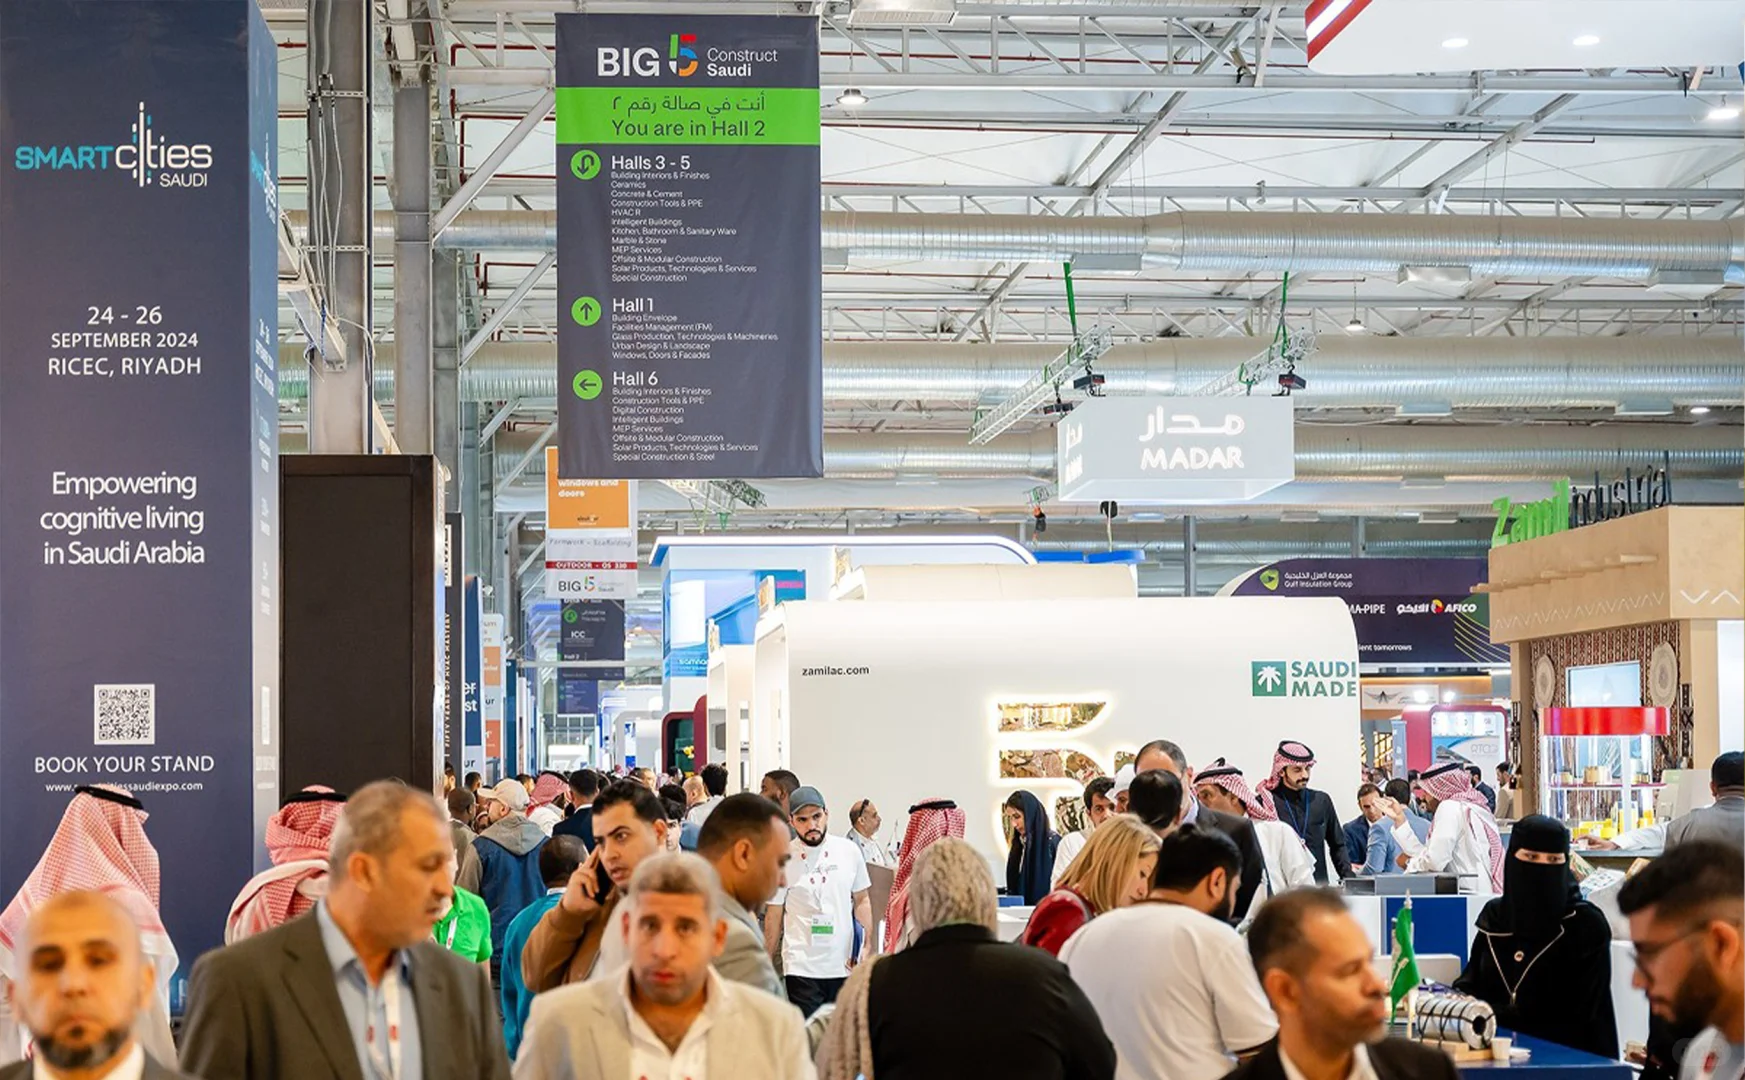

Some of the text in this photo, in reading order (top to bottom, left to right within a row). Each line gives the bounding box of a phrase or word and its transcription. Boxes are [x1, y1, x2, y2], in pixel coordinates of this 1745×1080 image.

[707, 48, 778, 62] Construct
[598, 48, 660, 77] BIG
[706, 63, 751, 76] Saudi
[662, 96, 700, 110] صالة
[736, 90, 765, 110] أنت
[628, 97, 656, 118] رقم
[706, 97, 730, 118] في
[612, 119, 765, 136] You are in Hall 2
[611, 156, 651, 170] Halls
[655, 156, 666, 170] 3
[680, 156, 690, 170] 5
[160, 173, 208, 187] SAUDI
[611, 171, 710, 180] Building Interiors Finishes
[610, 181, 646, 189] Ceramics
[610, 190, 682, 198] Concrete Cement
[610, 199, 703, 207] Construction Tools PPE
[612, 218, 682, 227] Intelligent Buildings
[612, 227, 736, 236] Kitchen, Bathroom Sanitary Ware
[612, 236, 666, 244] Marble Stone
[612, 246, 662, 254] MEP Services
[612, 255, 722, 263] Offsite Modular Construction
[612, 264, 757, 274] Solar Products, Technologies Services
[612, 274, 687, 282] Special Construction
[613, 298, 654, 312] Hall 1
[87, 306, 114, 325] 24
[136, 306, 162, 325] 26
[612, 315, 678, 323] Building Envelope
[612, 324, 713, 333] Facilities Management (FM)
[51, 332, 198, 348] SEPTEMBER 2024
[612, 333, 778, 342] Glass Production, Technologies Machineries
[612, 342, 710, 351] Urban Design Landscape
[612, 352, 648, 360] Windows,
[650, 352, 671, 360] Doors
[48, 357, 201, 378] RICEC, RIYADH
[613, 371, 658, 386] Hall 6
[612, 387, 712, 396] Building Interiors Finishes
[612, 397, 705, 405] Construction Tools PPE
[612, 406, 685, 415] Digital Construction
[612, 415, 684, 424] Intelligent Buildings
[1139, 405, 1245, 442] مدار
[612, 434, 723, 442] Offsite Modular Construction
[613, 443, 758, 452] Solar Products, Technologies Services
[613, 453, 640, 461] Special
[1140, 446, 1244, 470] MADAR
[52, 471, 197, 500] Empowering
[558, 490, 585, 498] doors
[40, 505, 204, 535] cognitive living
[44, 541, 205, 564] in Saudi Arabia
[558, 581, 581, 592] BIG
[1284, 580, 1353, 588] Gulf Insulation Group
[1444, 603, 1477, 613] AFICO
[802, 665, 869, 676] zamilac.com
[1291, 661, 1356, 678] SAUDI
[1292, 681, 1356, 697] MADE
[35, 755, 214, 773] BOOK YOUR STAND
